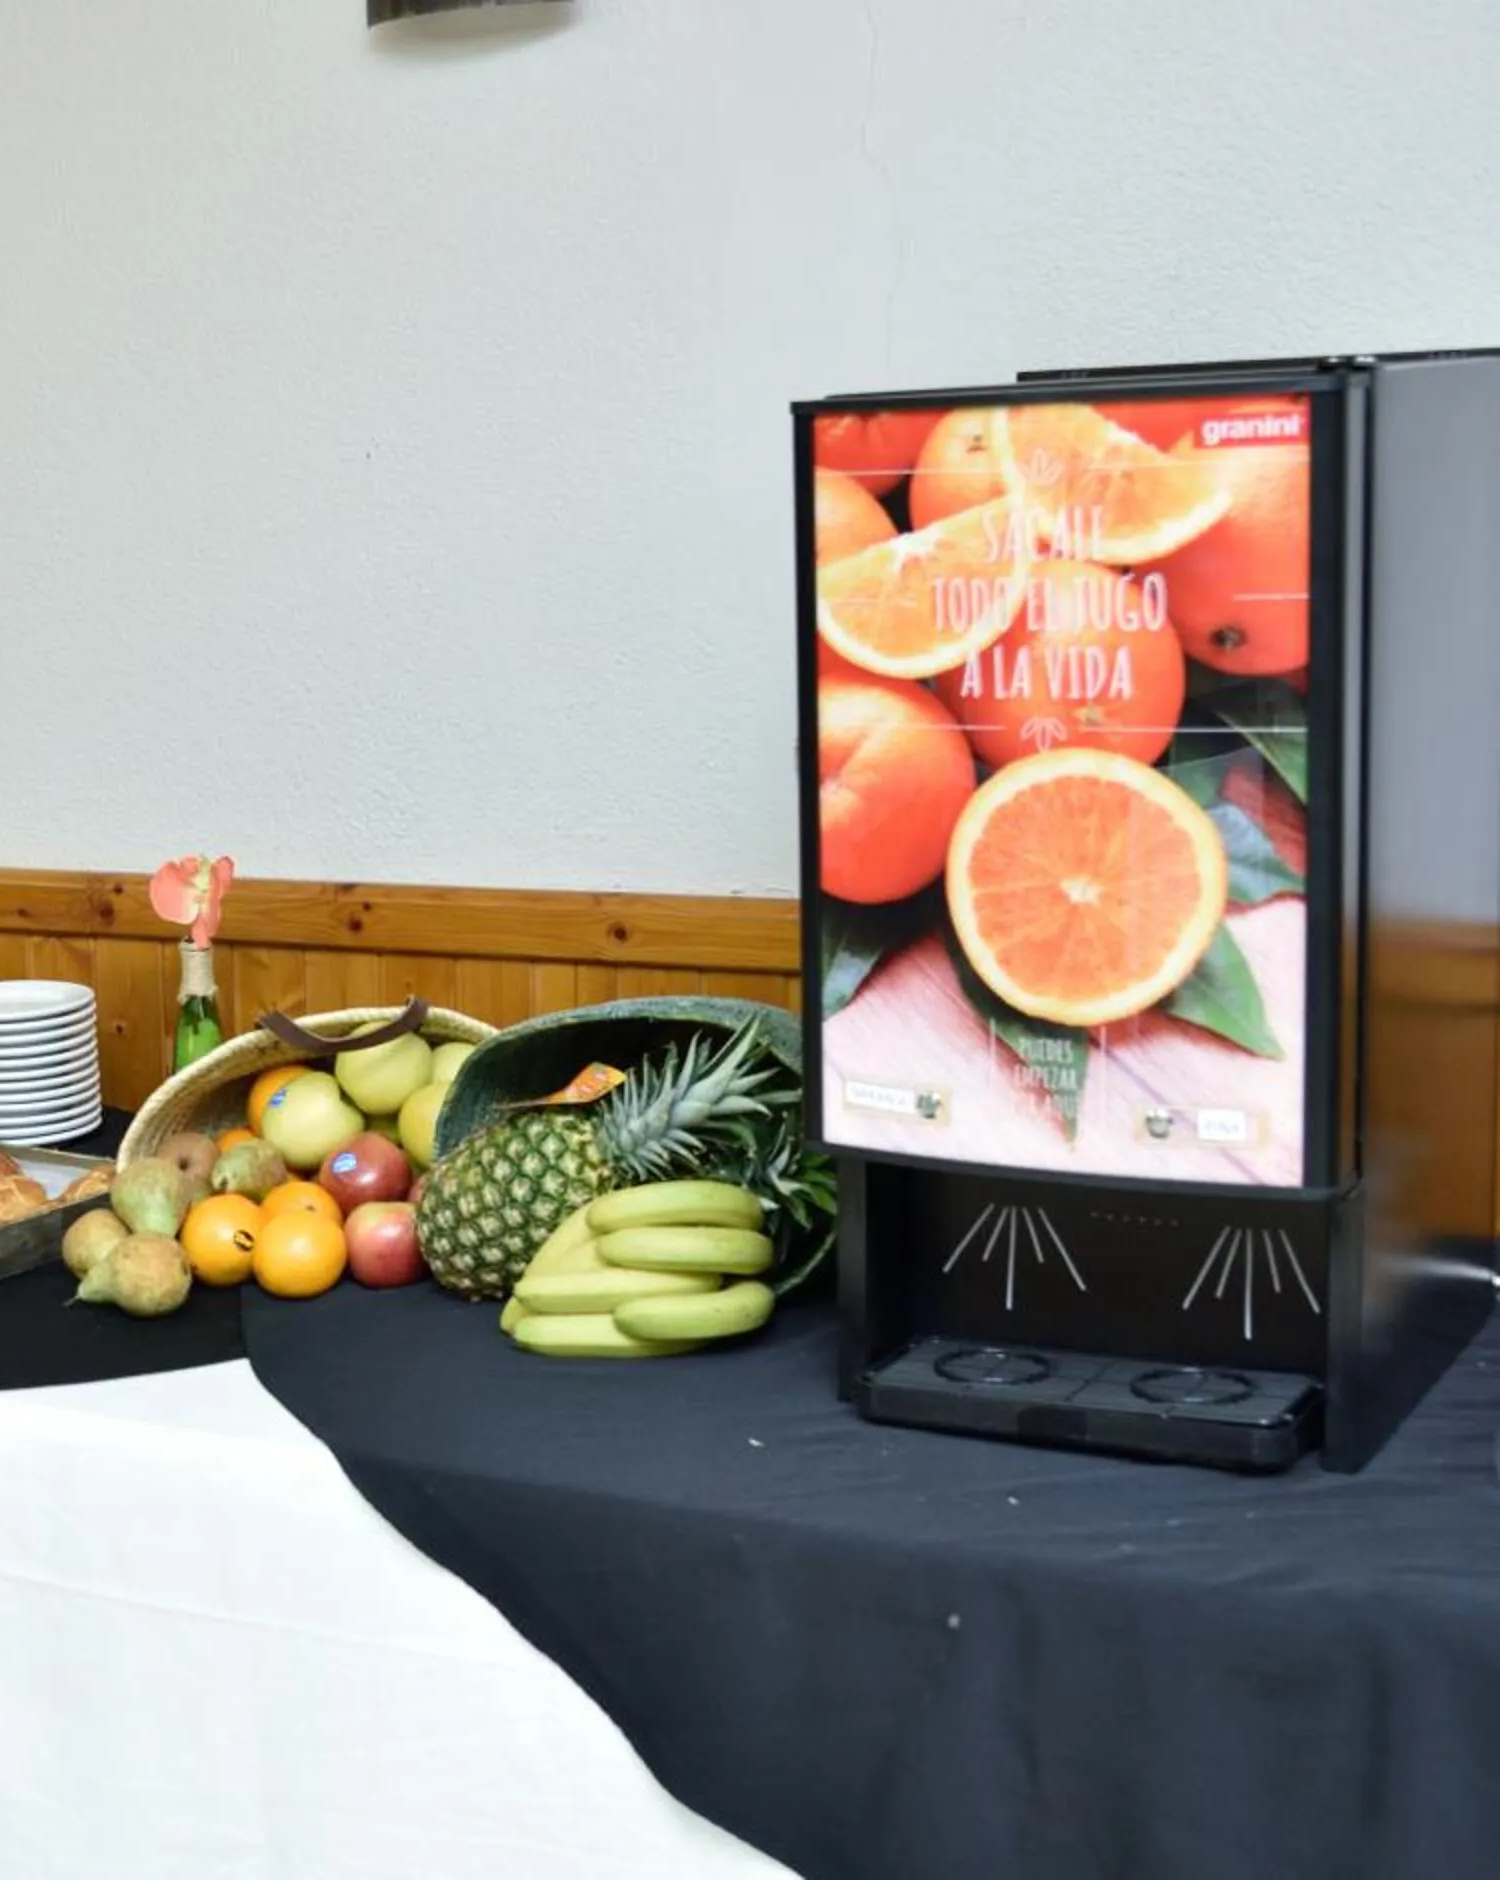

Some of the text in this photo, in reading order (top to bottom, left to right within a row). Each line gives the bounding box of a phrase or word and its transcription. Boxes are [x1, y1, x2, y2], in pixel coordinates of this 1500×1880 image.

[1202, 413, 1298, 446] granini
[933, 571, 1168, 633] TODO EL JUGO
[959, 643, 1132, 701] A LA VIDA
